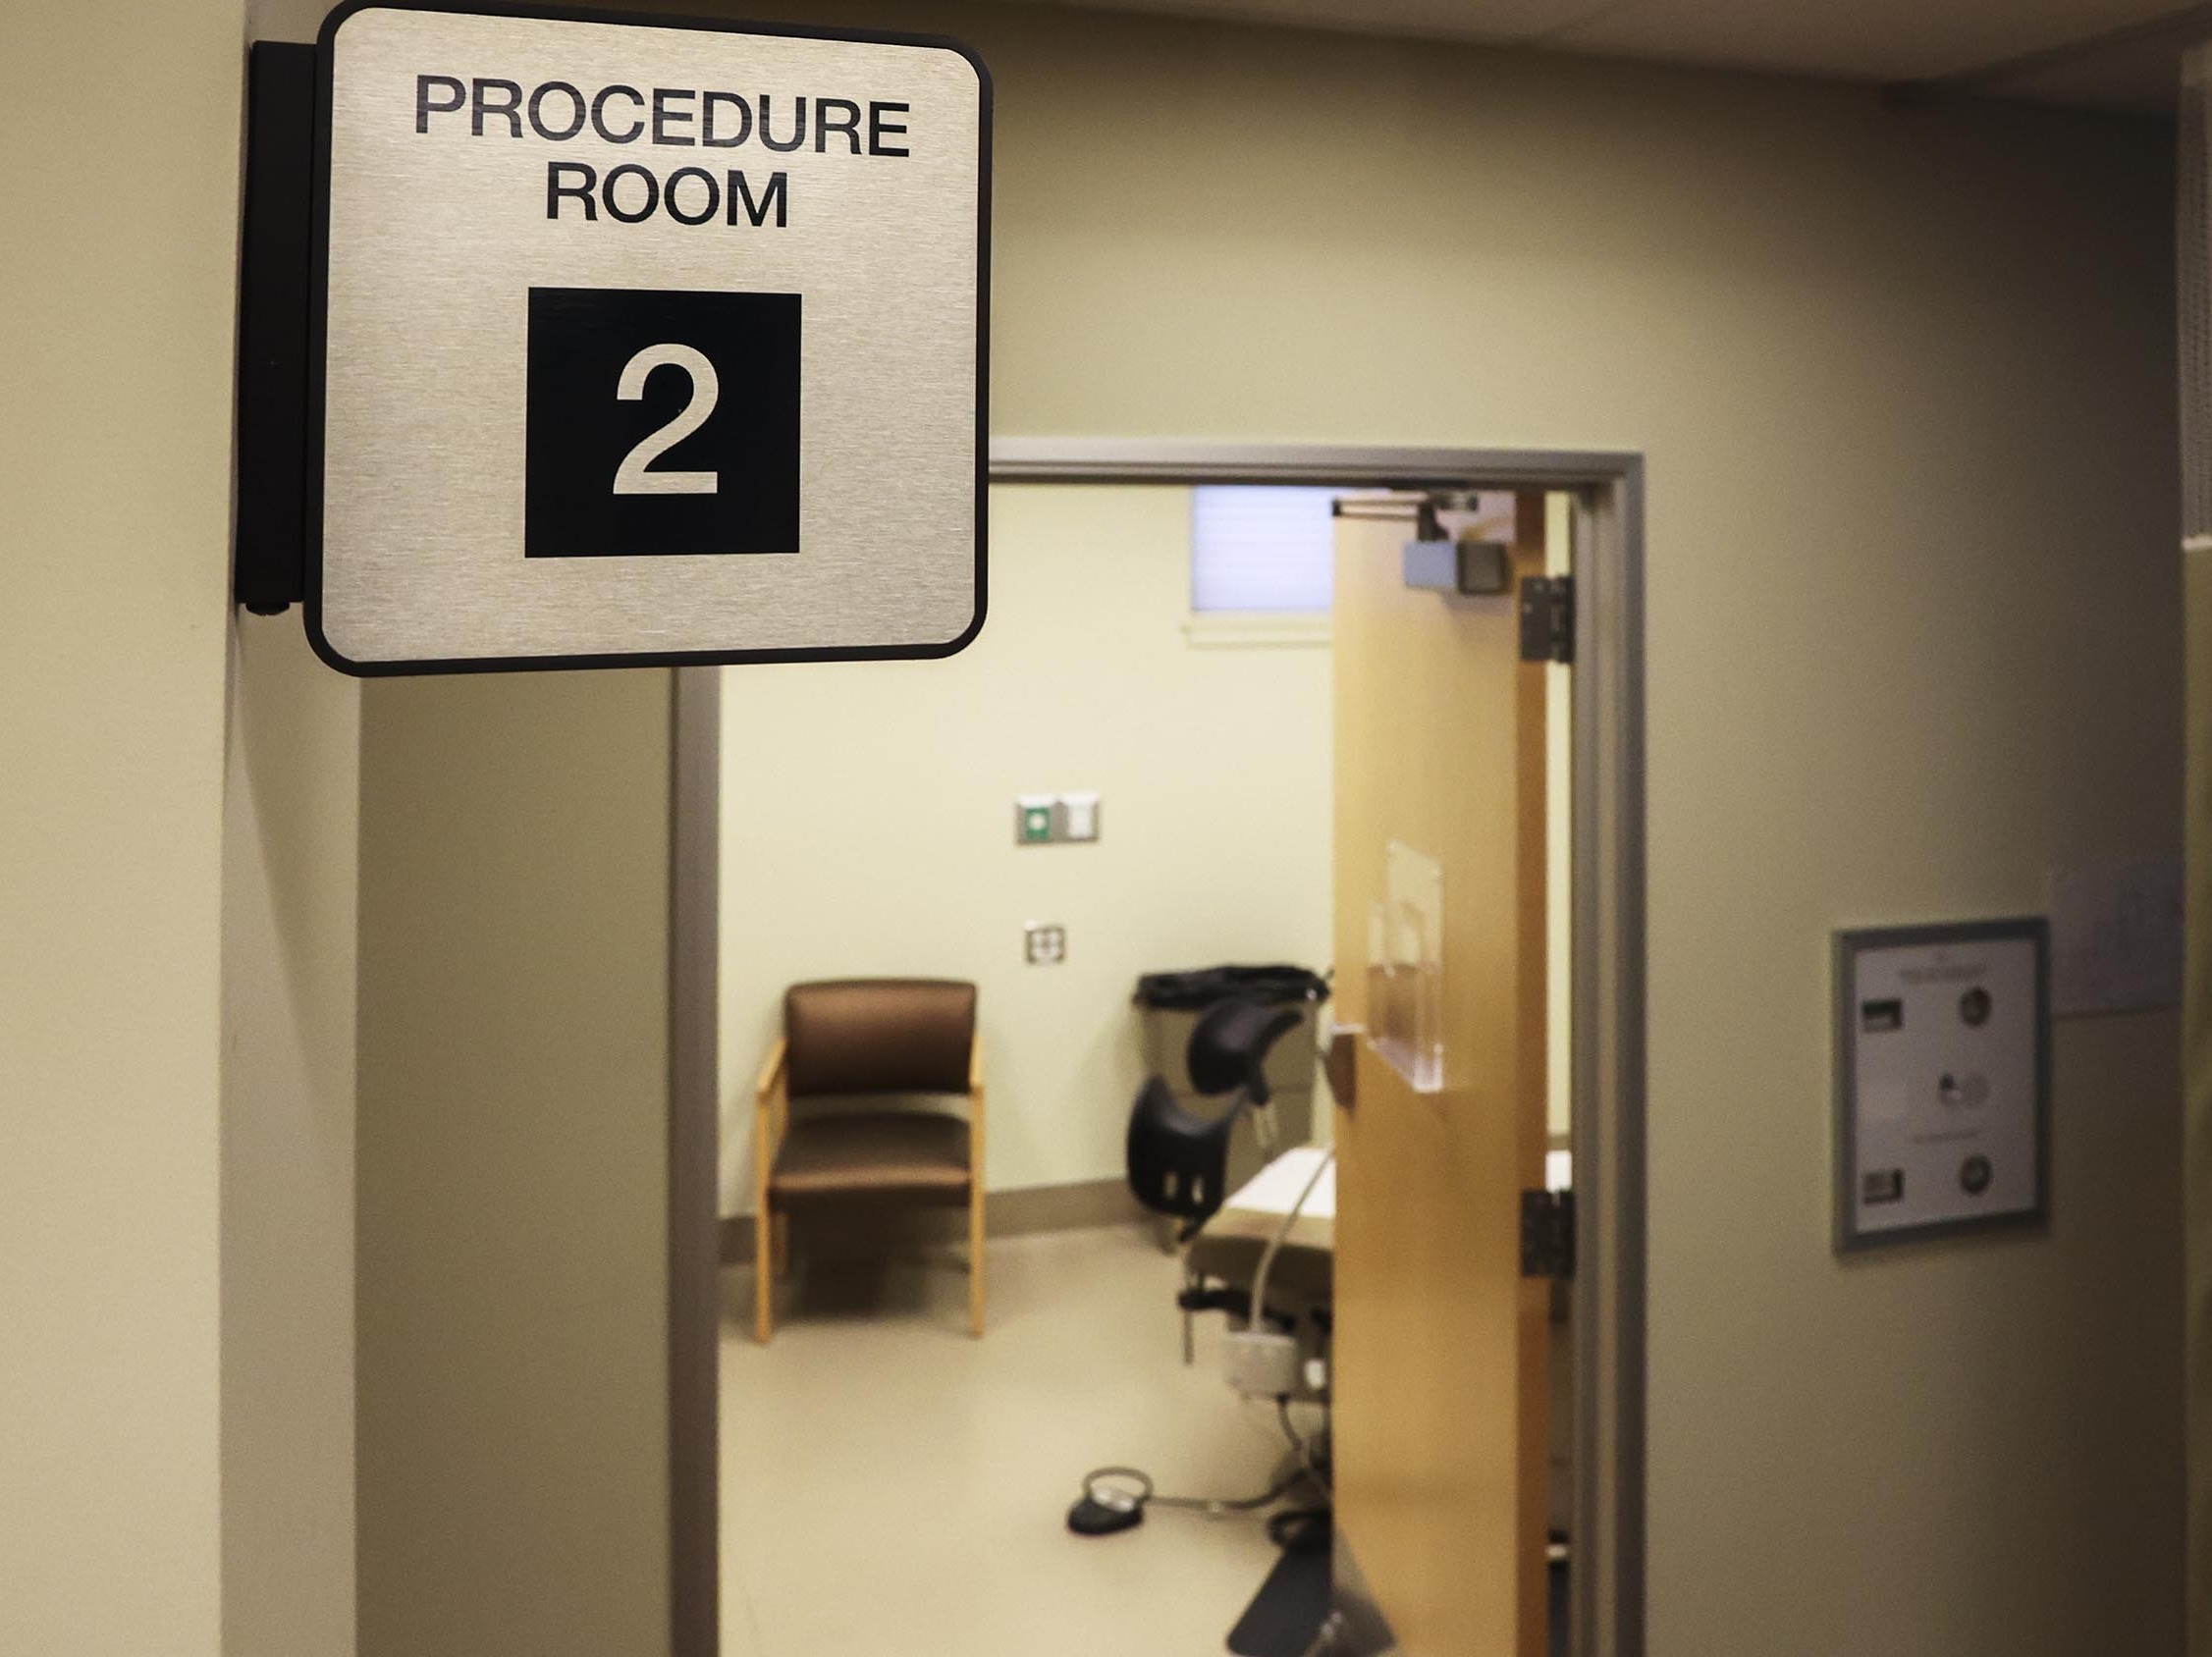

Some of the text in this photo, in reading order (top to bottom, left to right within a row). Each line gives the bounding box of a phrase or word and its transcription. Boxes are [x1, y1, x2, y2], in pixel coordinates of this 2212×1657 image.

[415, 75, 910, 157] PROCEDURE
[546, 161, 787, 228] ROOM
[613, 344, 719, 495] 2
